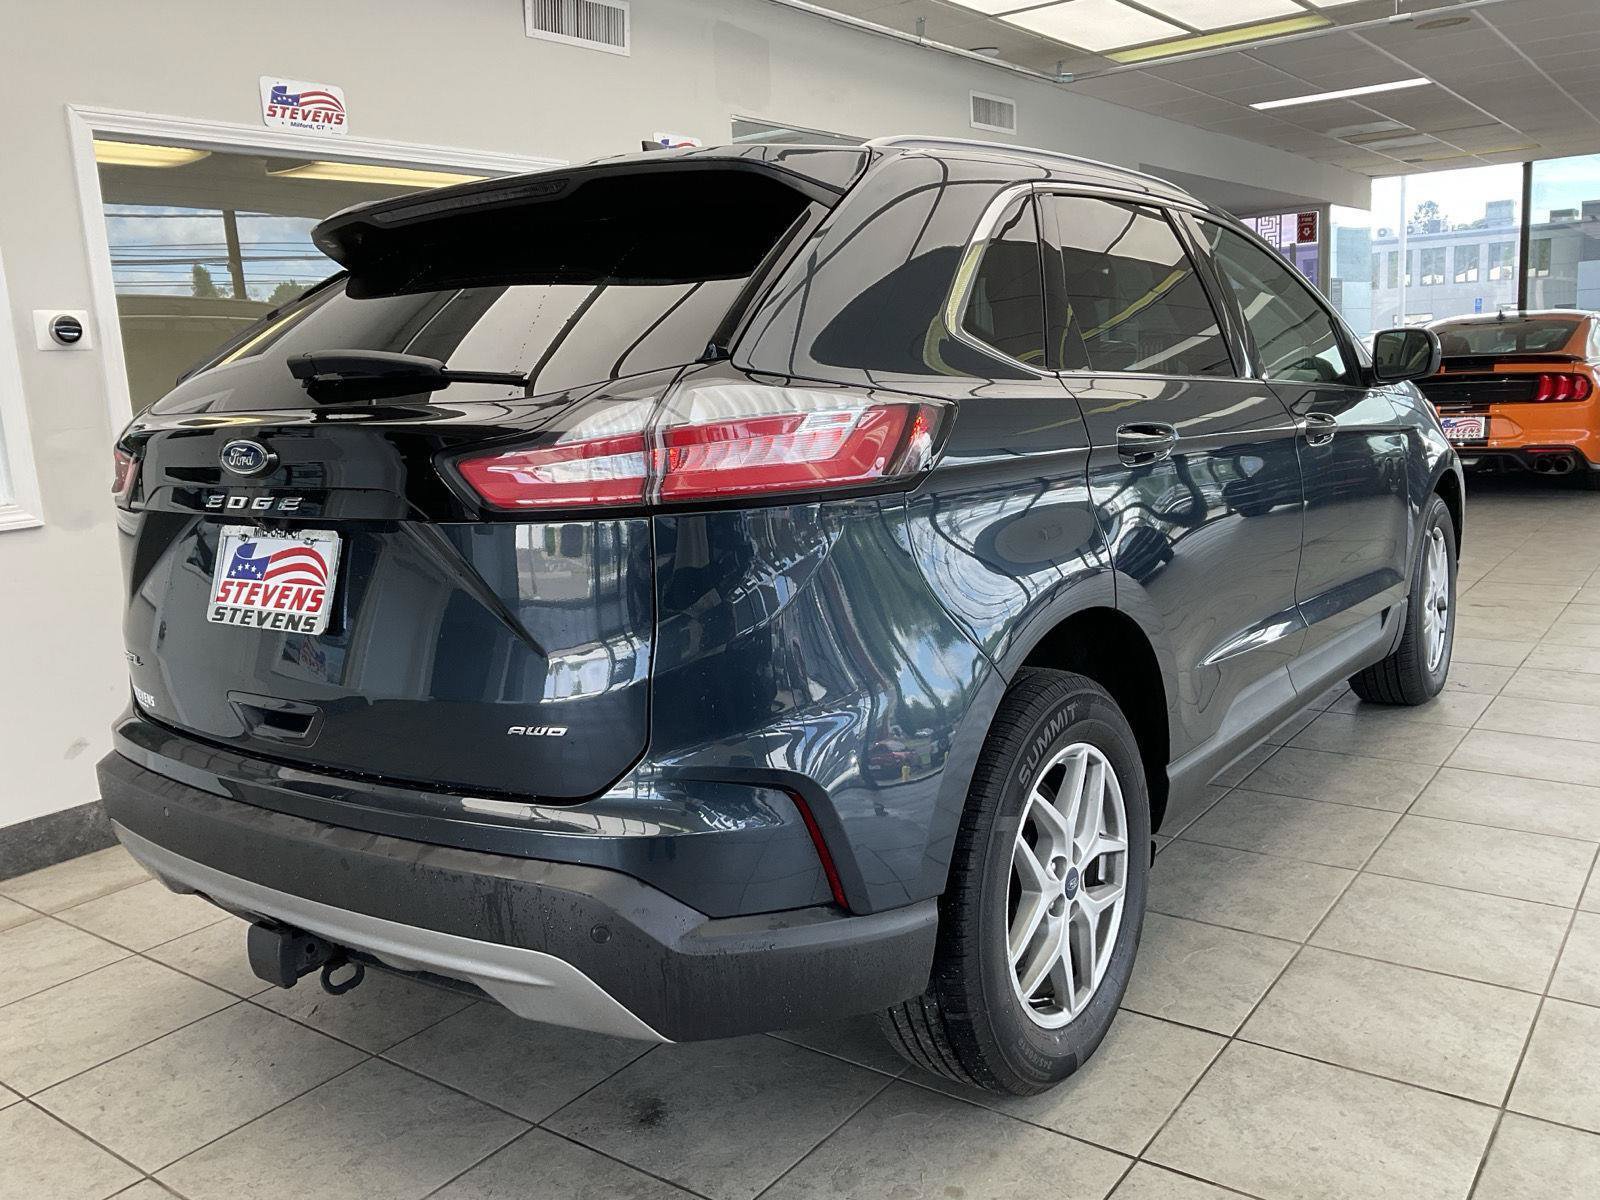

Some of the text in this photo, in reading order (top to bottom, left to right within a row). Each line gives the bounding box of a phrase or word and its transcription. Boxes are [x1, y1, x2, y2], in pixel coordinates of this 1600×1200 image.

[266, 105, 345, 125] STEVENS
[290, 121, 314, 130] Milford,
[228, 447, 255, 467] Ford
[205, 494, 303, 511] EDGE
[216, 580, 326, 613] STEVENS
[211, 606, 318, 633] STEVENS
[507, 726, 568, 737] AWD
[1018, 700, 1077, 789] SUMMIT
